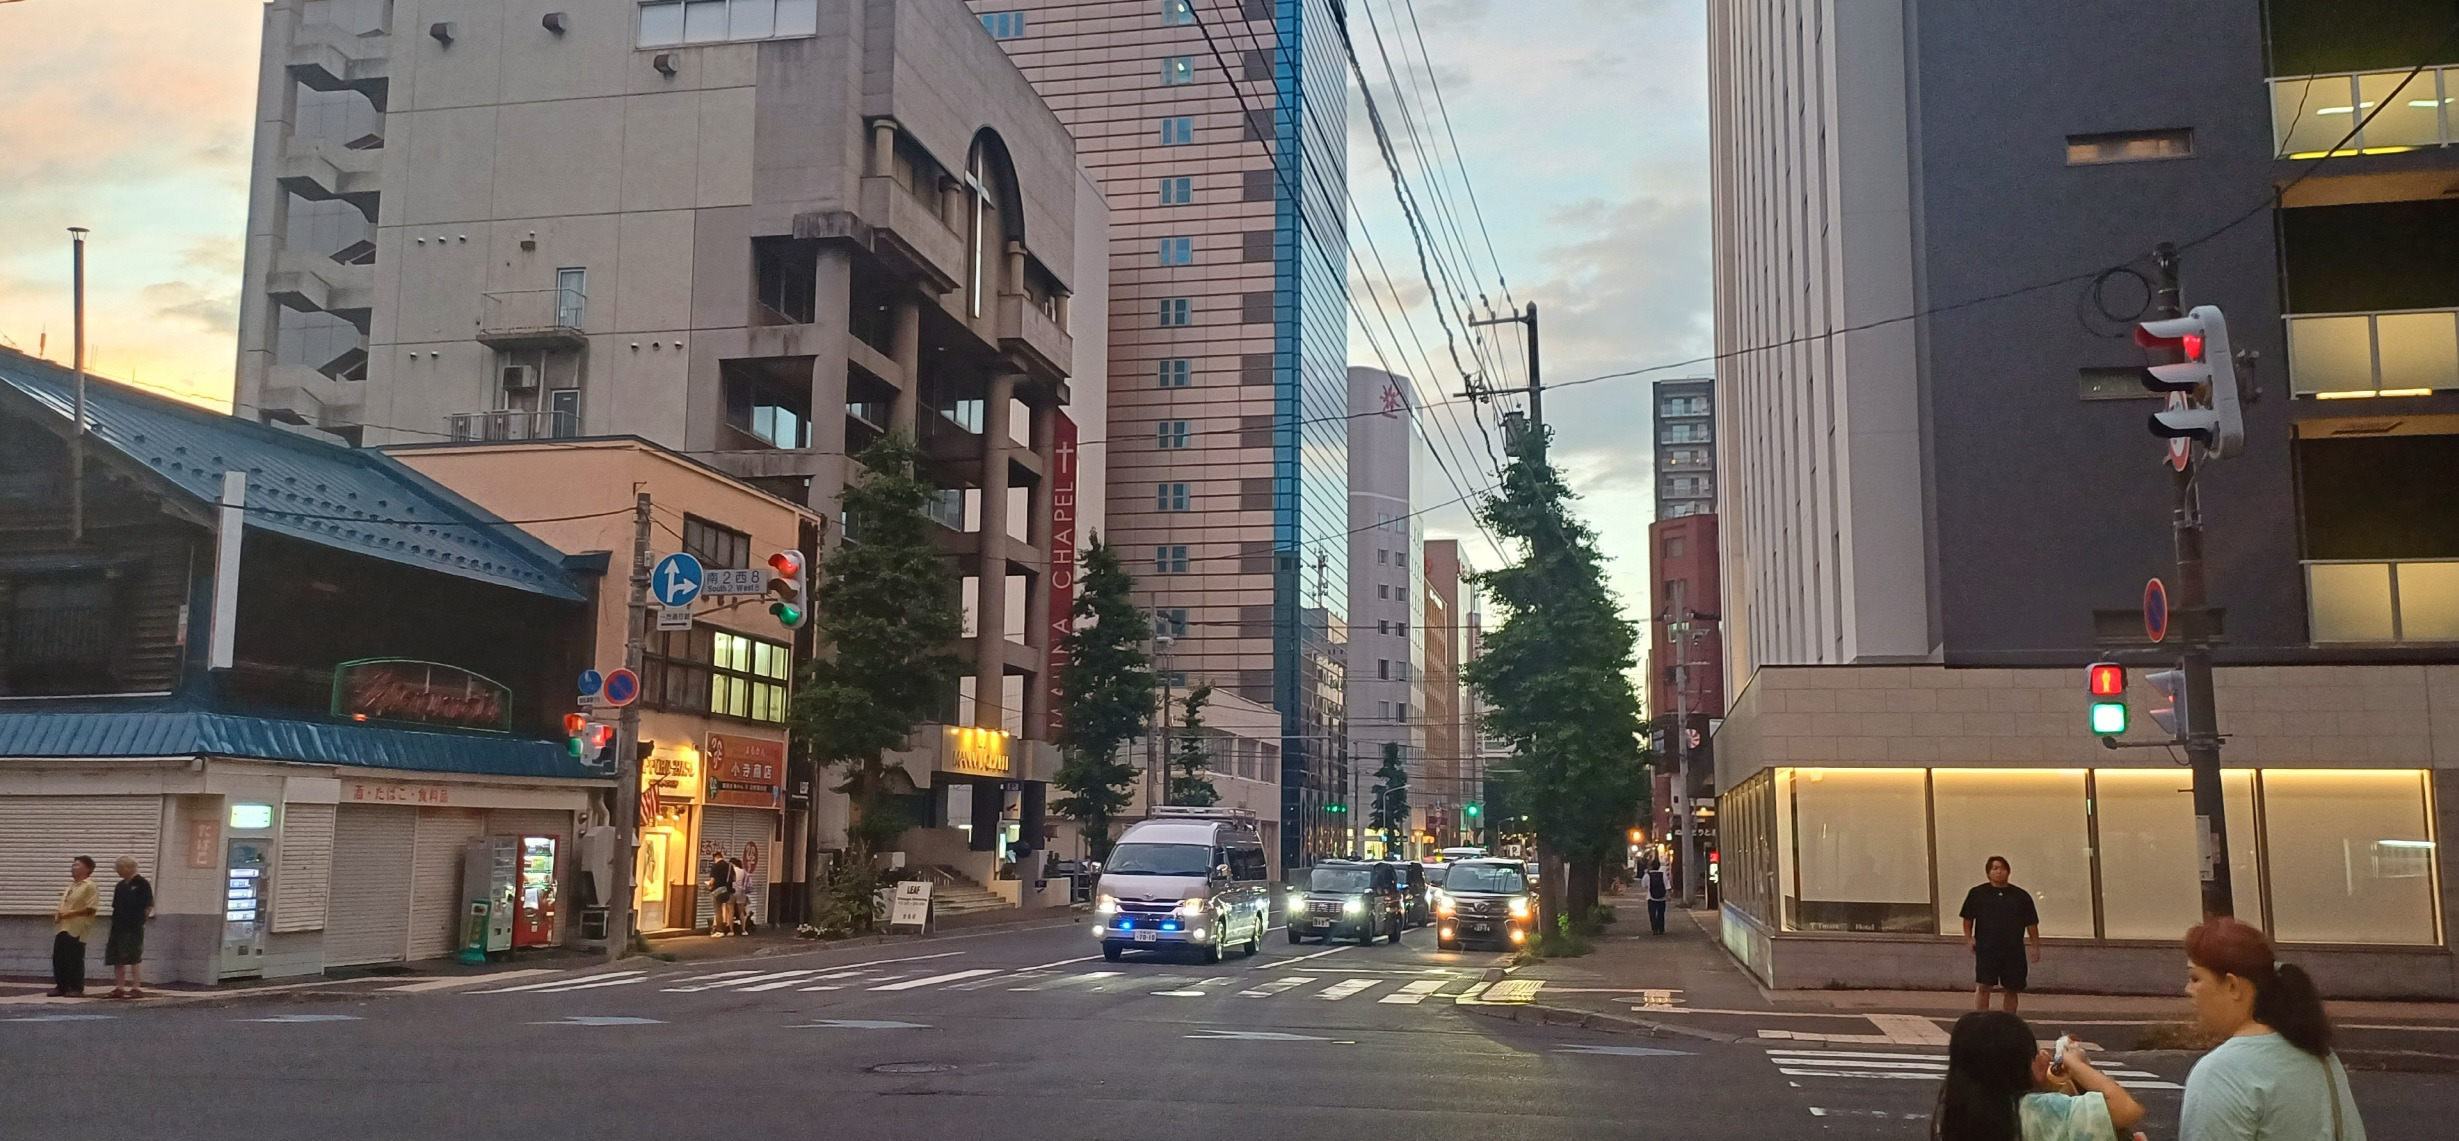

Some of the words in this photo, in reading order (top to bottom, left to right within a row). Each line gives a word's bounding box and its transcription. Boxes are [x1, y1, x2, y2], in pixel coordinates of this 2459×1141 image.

[1052, 481, 1075, 589] CHAPEL
[707, 585, 727, 593] South
[731, 761, 773, 779] 小寺商店
[906, 885, 921, 894] LEAF
